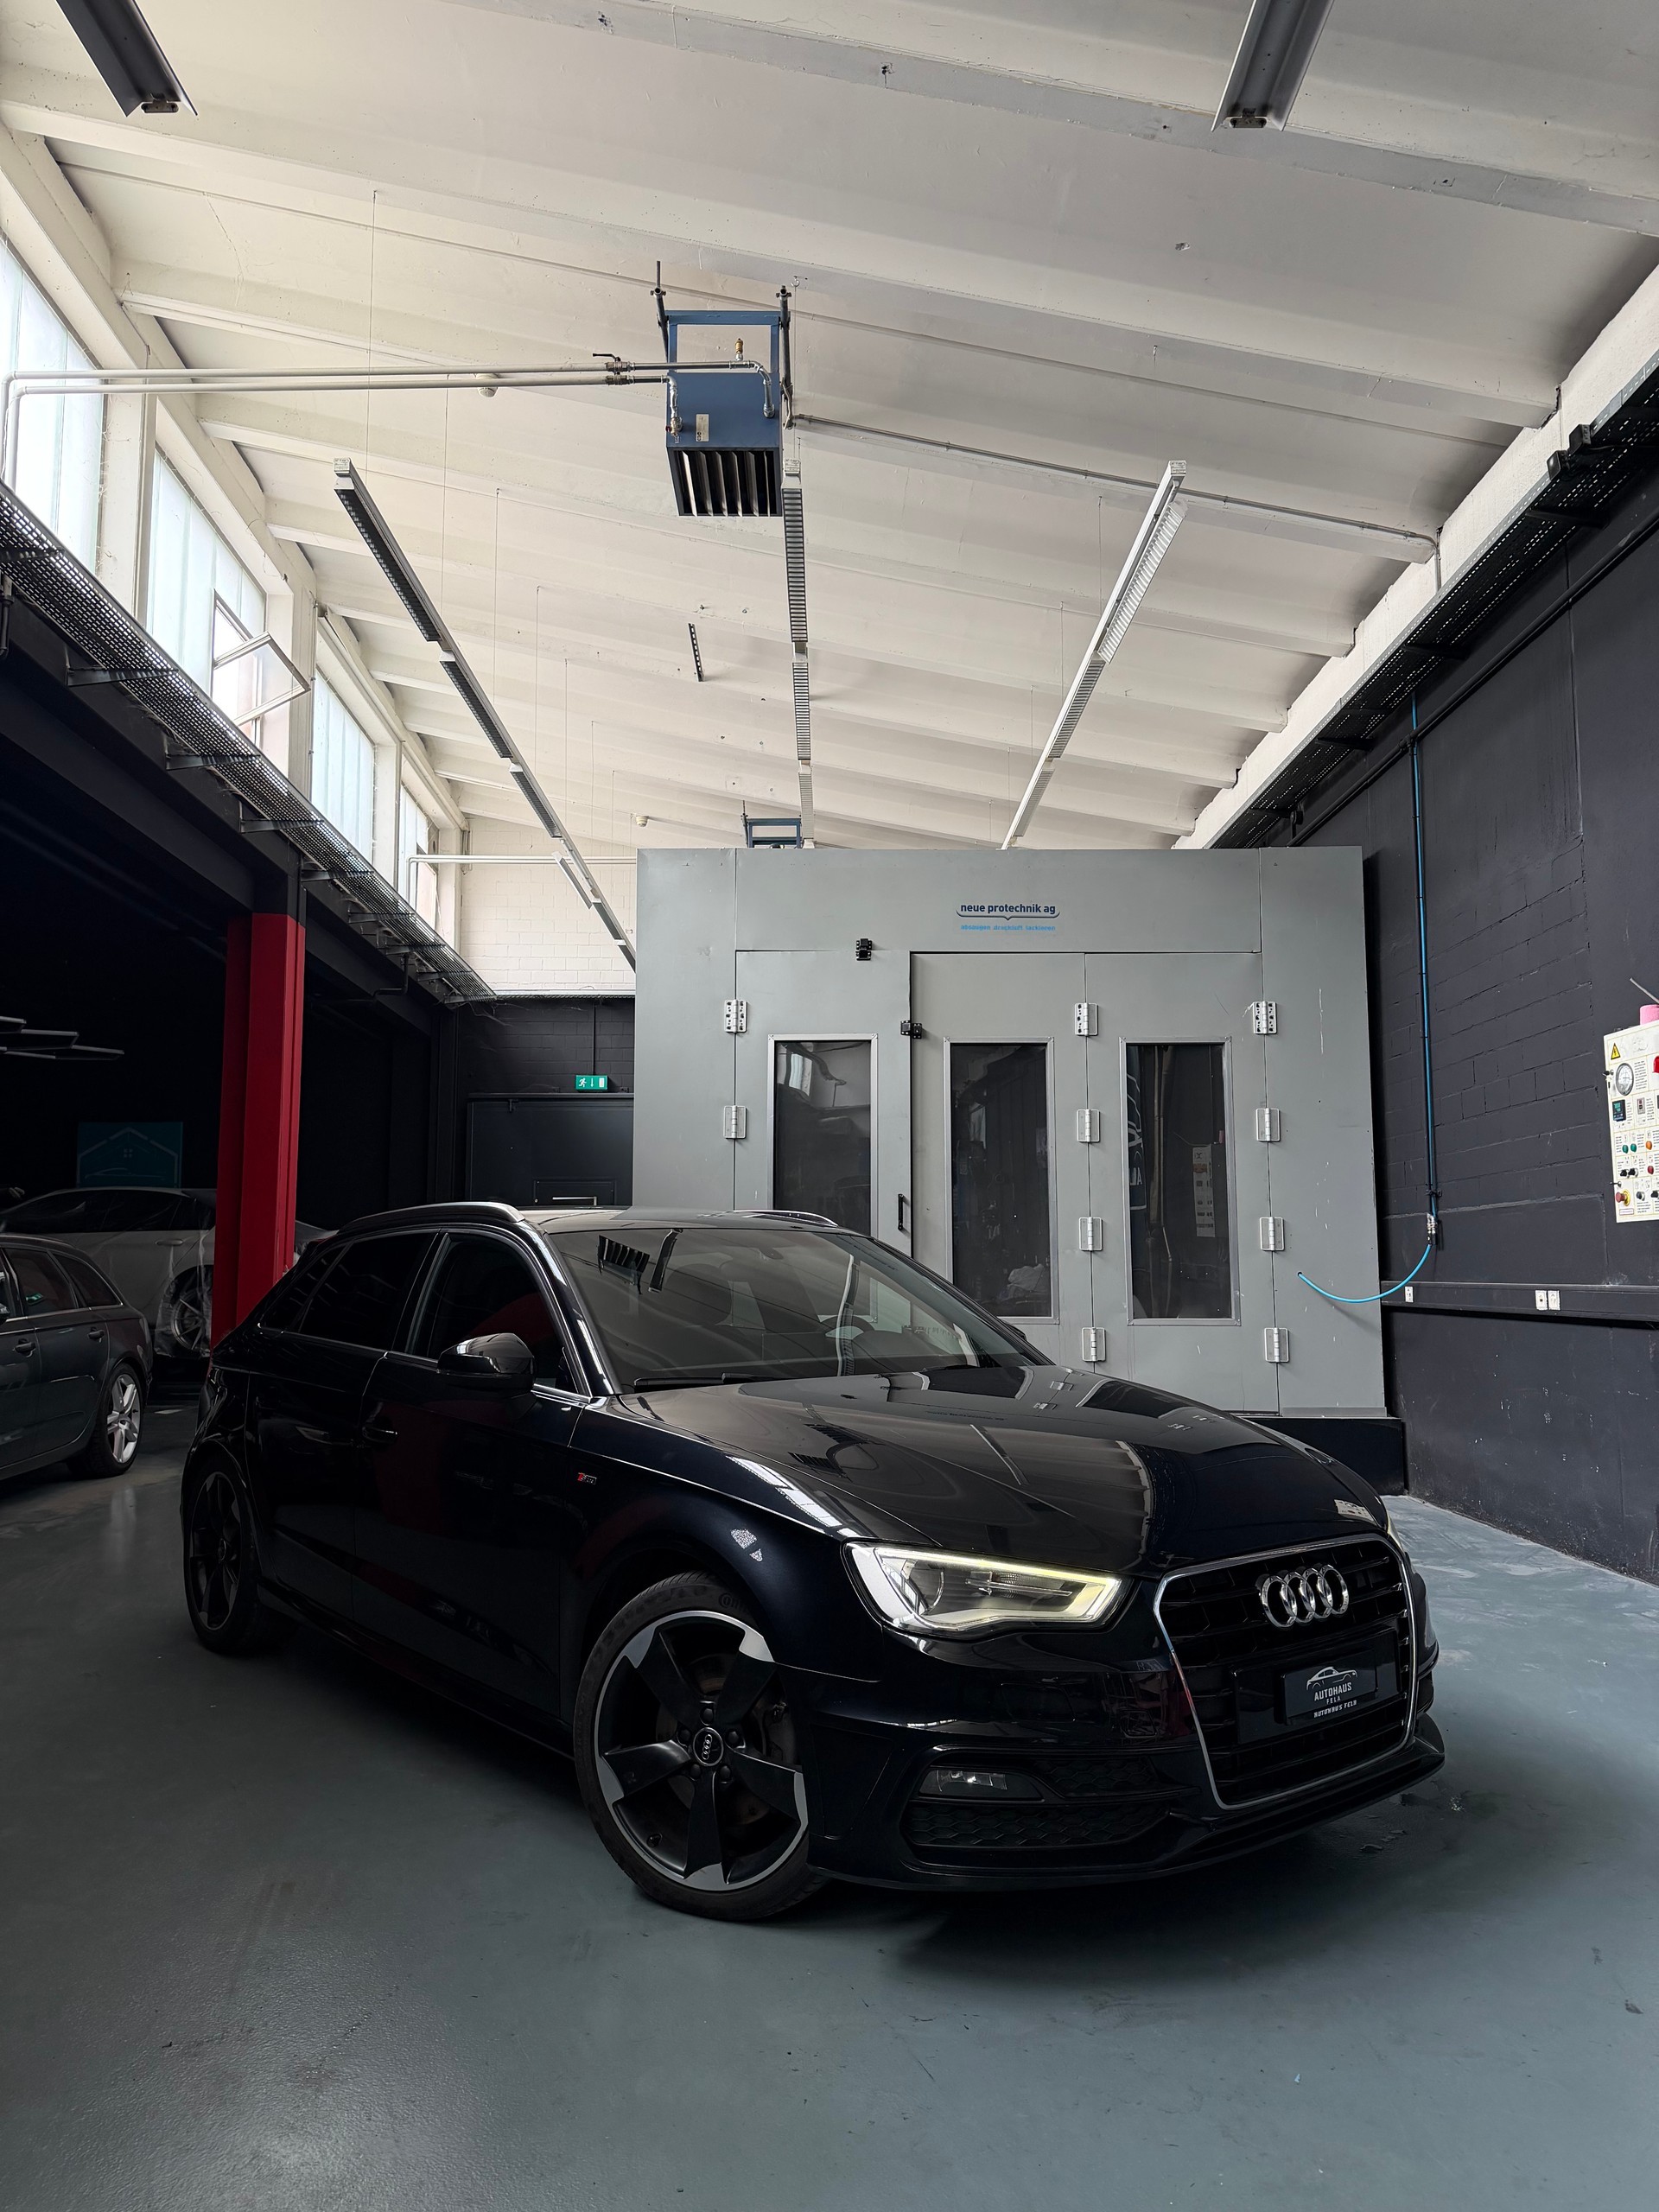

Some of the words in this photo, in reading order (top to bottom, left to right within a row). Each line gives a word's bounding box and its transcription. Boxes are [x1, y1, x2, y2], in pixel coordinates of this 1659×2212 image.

[988, 904, 1041, 914] protechnik
[1044, 906, 1056, 914] ag
[1314, 1682, 1351, 1701] AUTOHAUS
[1326, 1695, 1341, 1705] FELA
